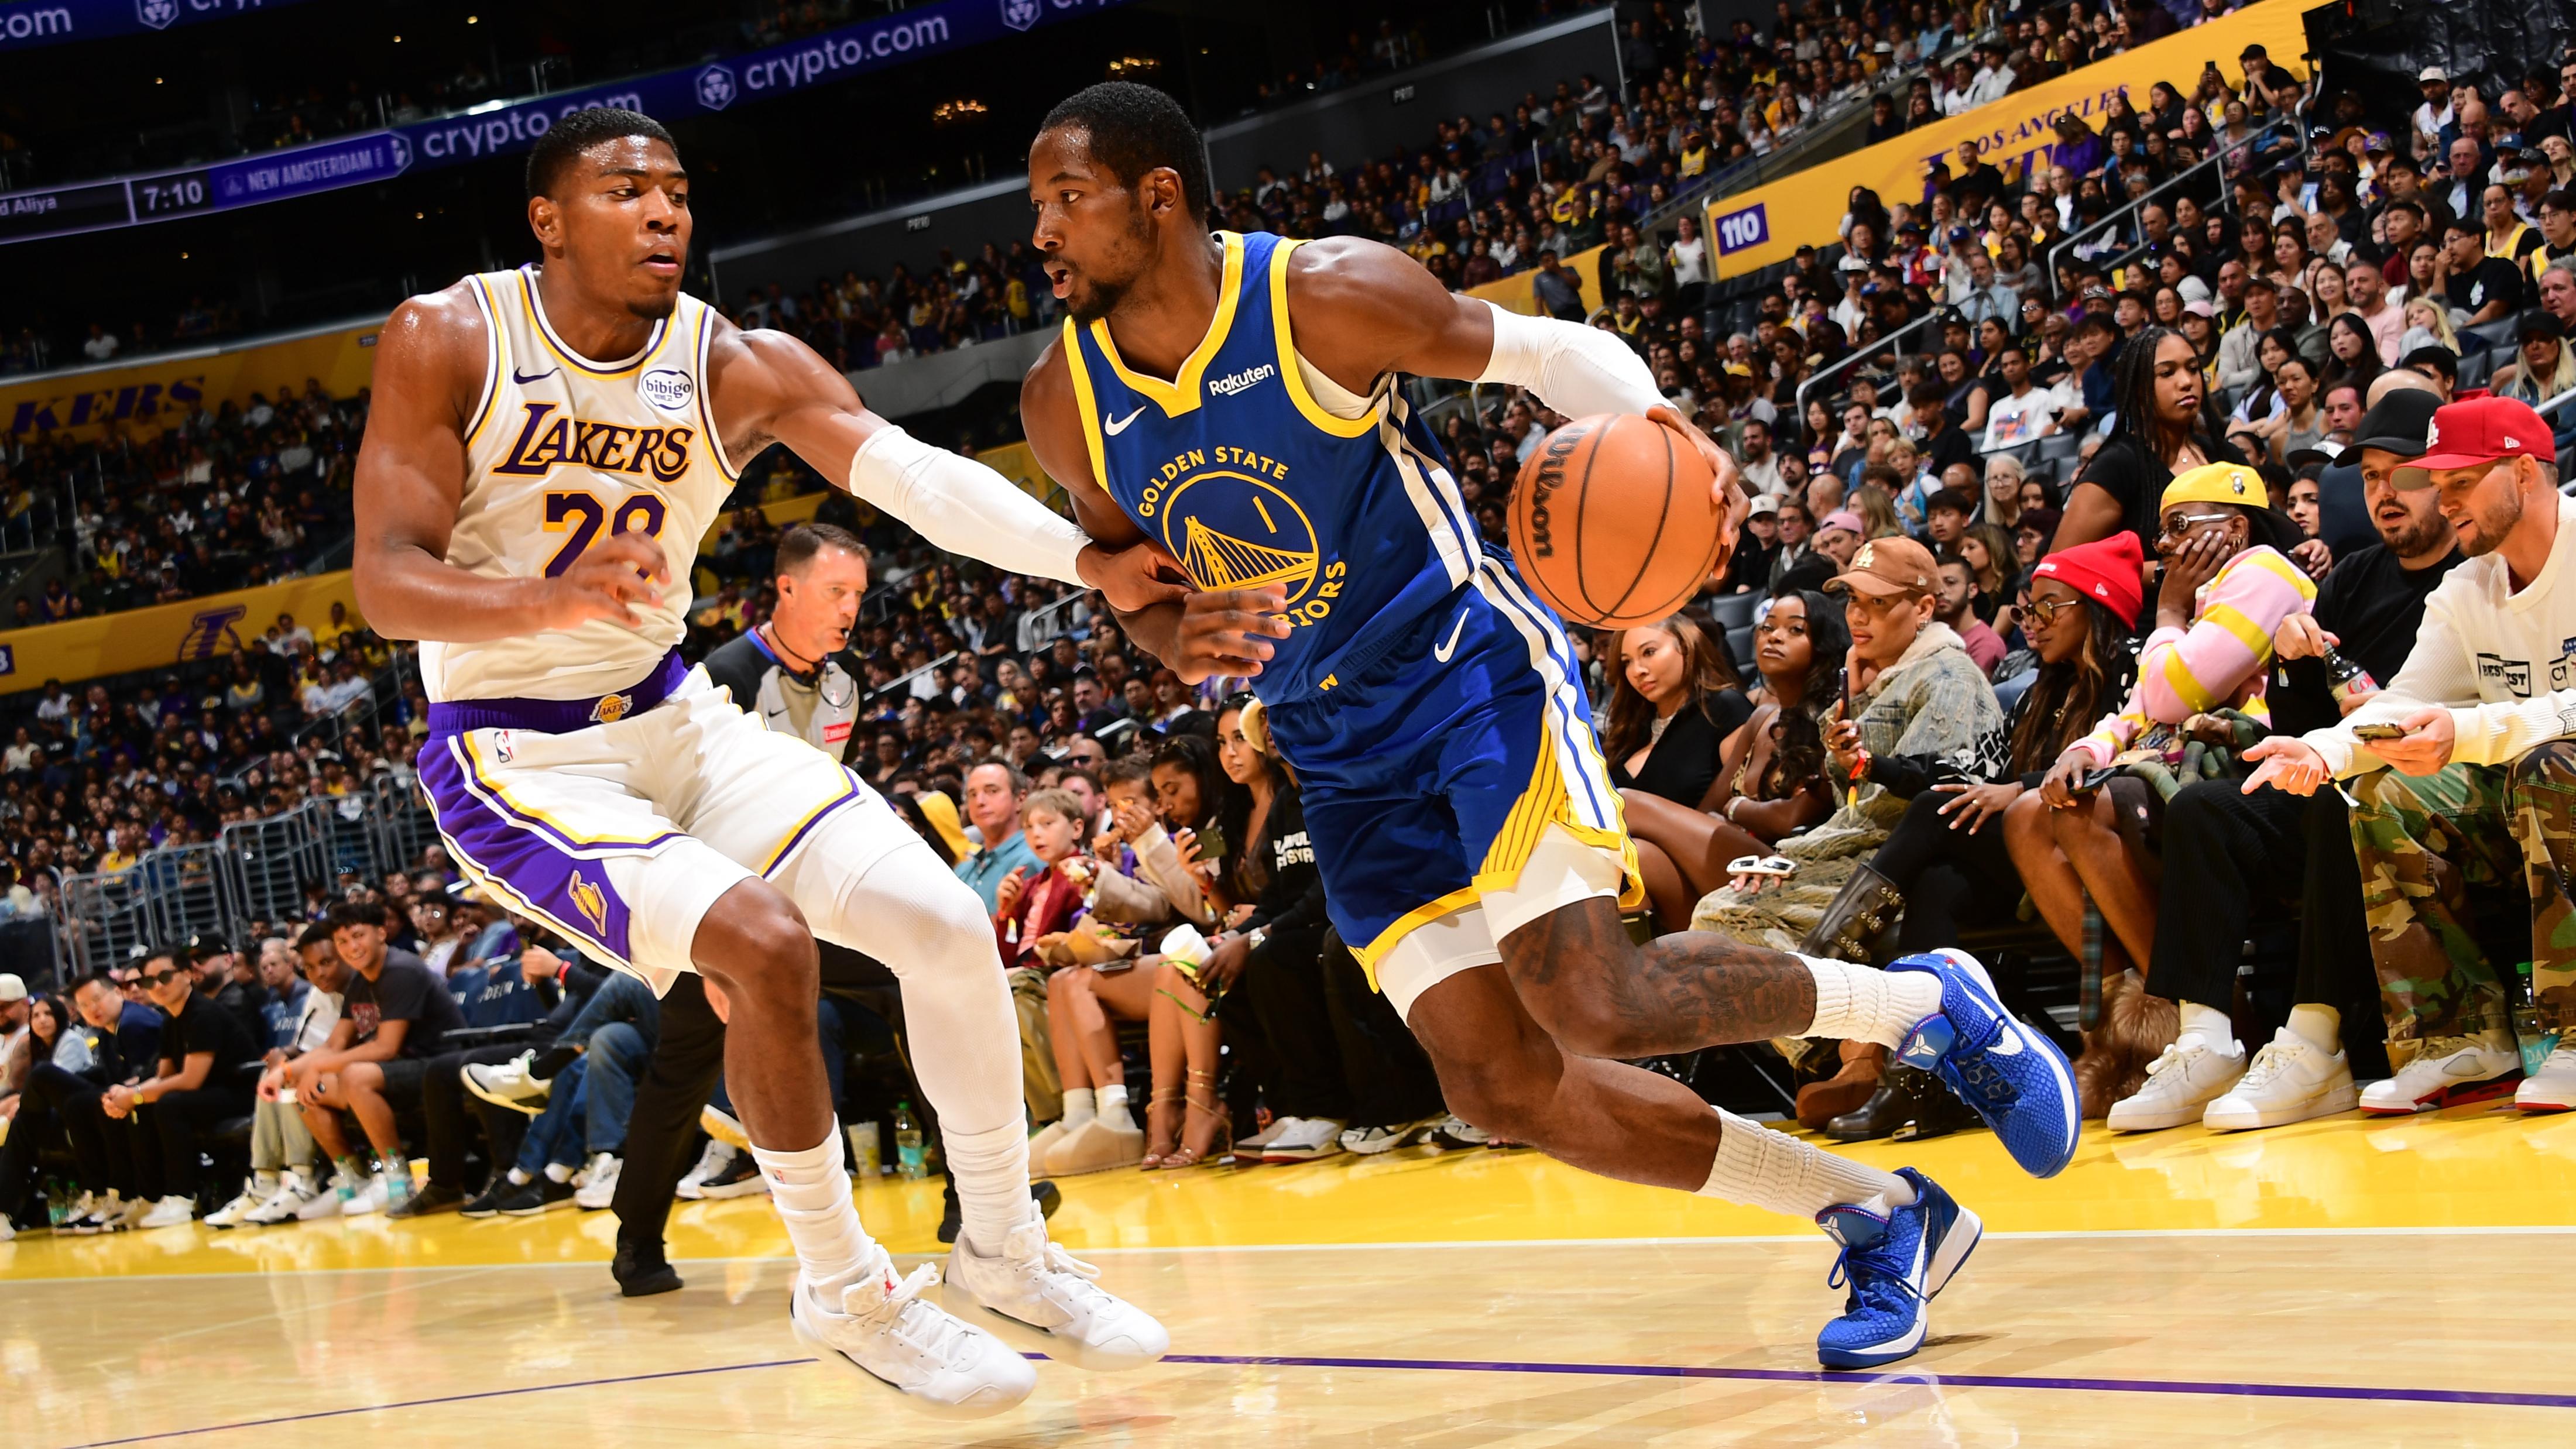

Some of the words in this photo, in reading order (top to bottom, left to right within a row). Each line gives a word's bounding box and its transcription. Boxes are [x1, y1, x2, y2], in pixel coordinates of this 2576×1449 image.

[0, 7, 73, 42] om
[745, 16, 949, 90] crypto.com
[248, 167, 280, 193] NEW
[282, 149, 373, 186] AMSTERDAM
[13, 197, 57, 215] Aliya
[143, 180, 203, 211] 7:10
[1721, 211, 1761, 248] 110
[645, 379, 691, 399] bibigo
[1208, 363, 1275, 397] Rakuten
[490, 401, 698, 485] LAKERS
[1138, 448, 1206, 517] GOLDEN
[1214, 446, 1289, 481] STATE
[1530, 424, 1593, 561] Wilson
